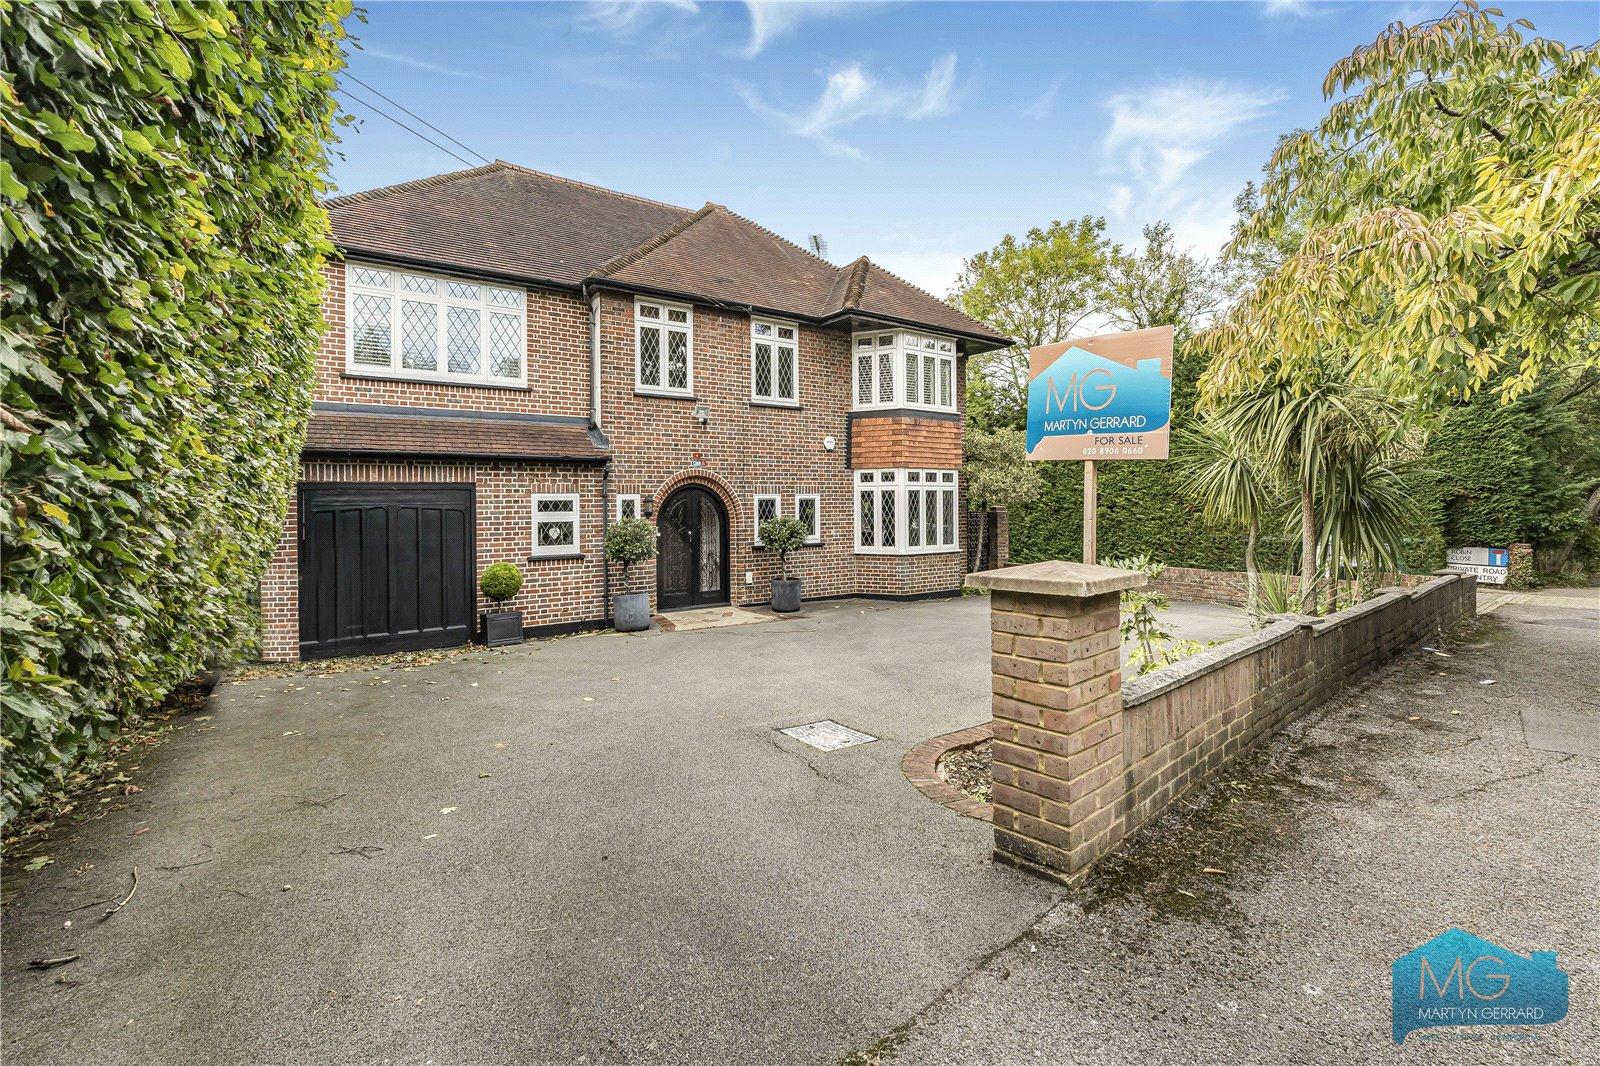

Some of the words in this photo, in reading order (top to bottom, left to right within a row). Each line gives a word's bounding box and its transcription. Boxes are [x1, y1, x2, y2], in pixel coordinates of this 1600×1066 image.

[1045, 368, 1118, 414] MG
[1044, 418, 1087, 431] MARTYN
[1089, 415, 1146, 429] GERRARD
[1094, 436, 1115, 446] FOR
[1118, 436, 1143, 445] SALE
[1082, 447, 1096, 455] 020
[1099, 447, 1119, 455] 8906
[1122, 447, 1143, 455] 0660
[1482, 567, 1507, 575] ROAD
[1476, 574, 1498, 582] NTRY
